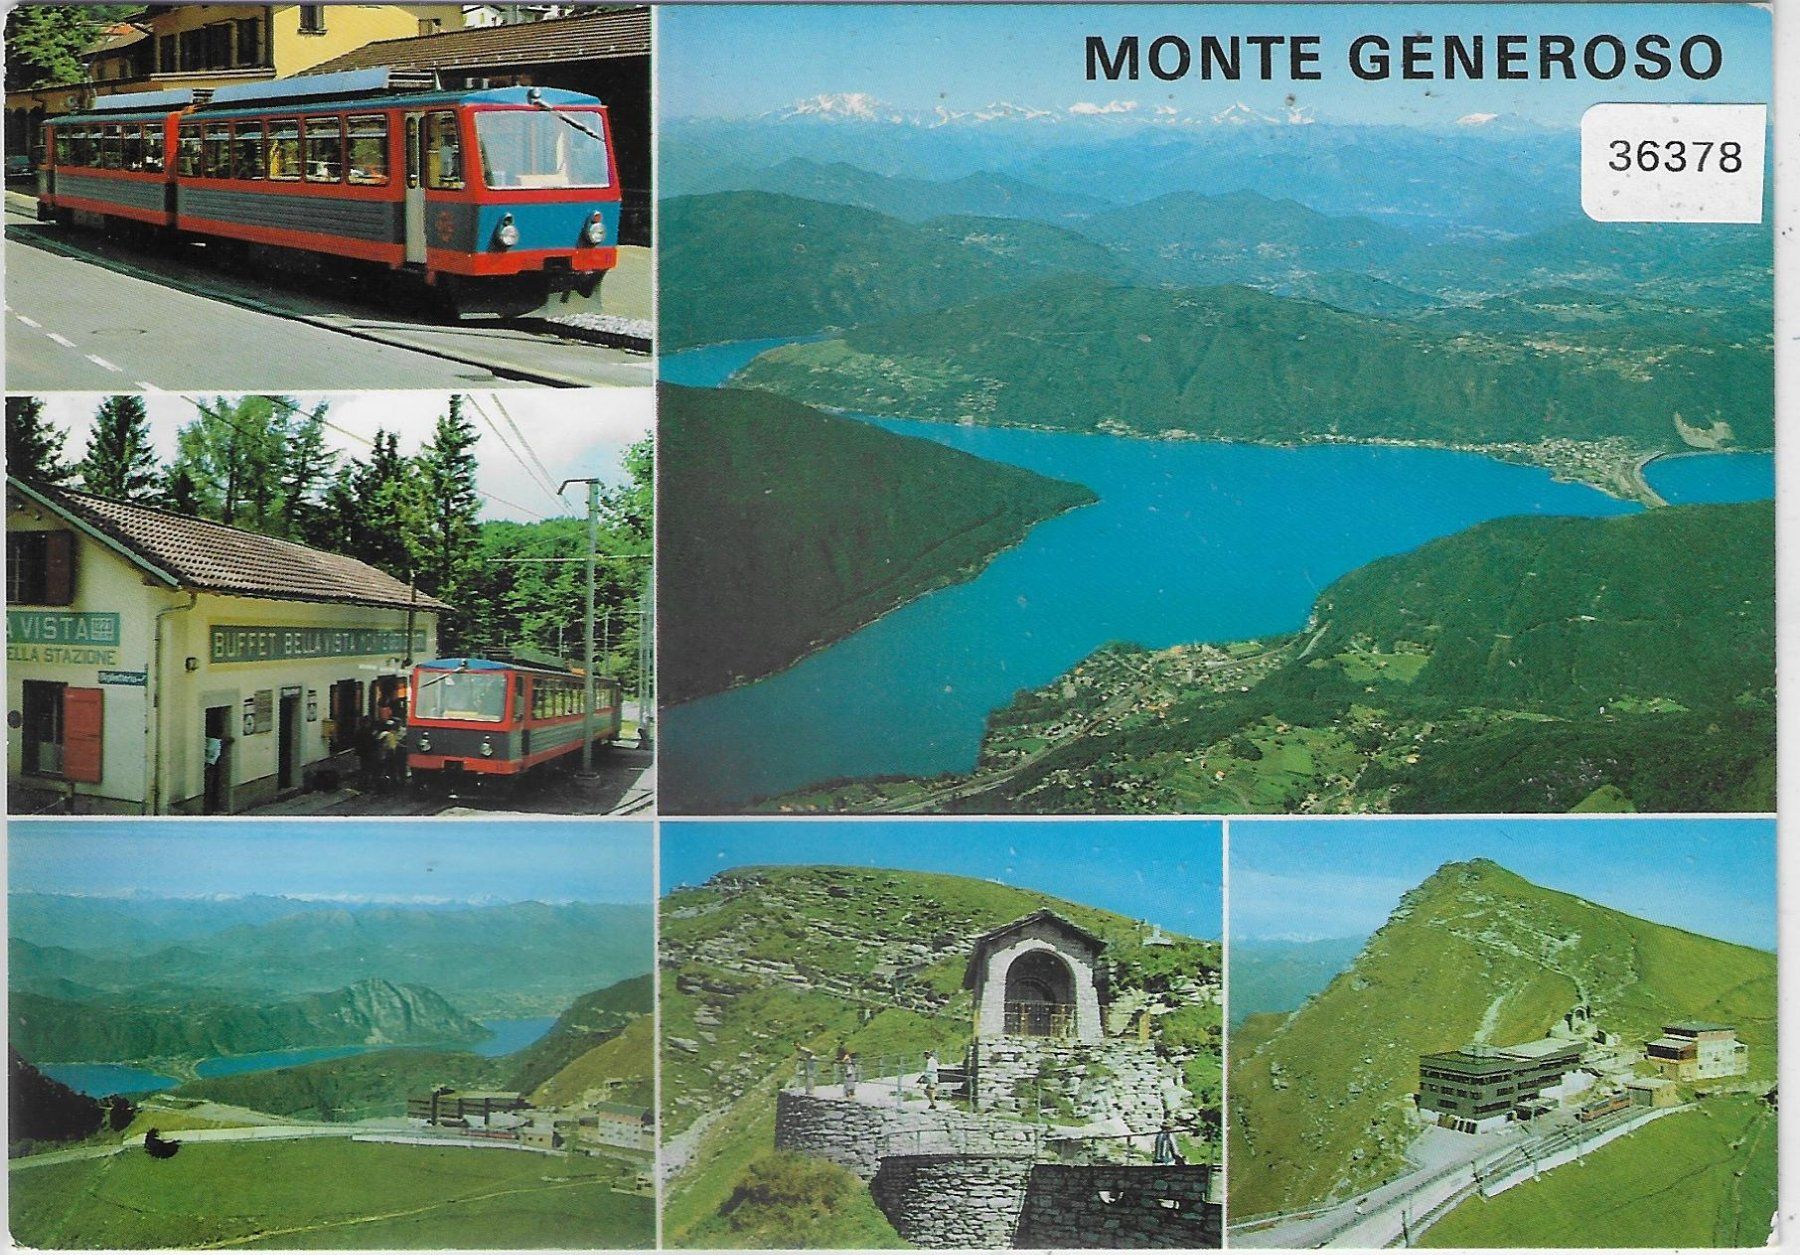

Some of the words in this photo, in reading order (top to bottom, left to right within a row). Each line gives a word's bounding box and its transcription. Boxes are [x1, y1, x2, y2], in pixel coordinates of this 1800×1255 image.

[1609, 140, 1742, 173] 36378
[21, 617, 89, 640] VISTA
[44, 647, 117, 666] STAZIONE
[214, 632, 277, 658] BUFFET
[285, 632, 321, 654] BELLA
